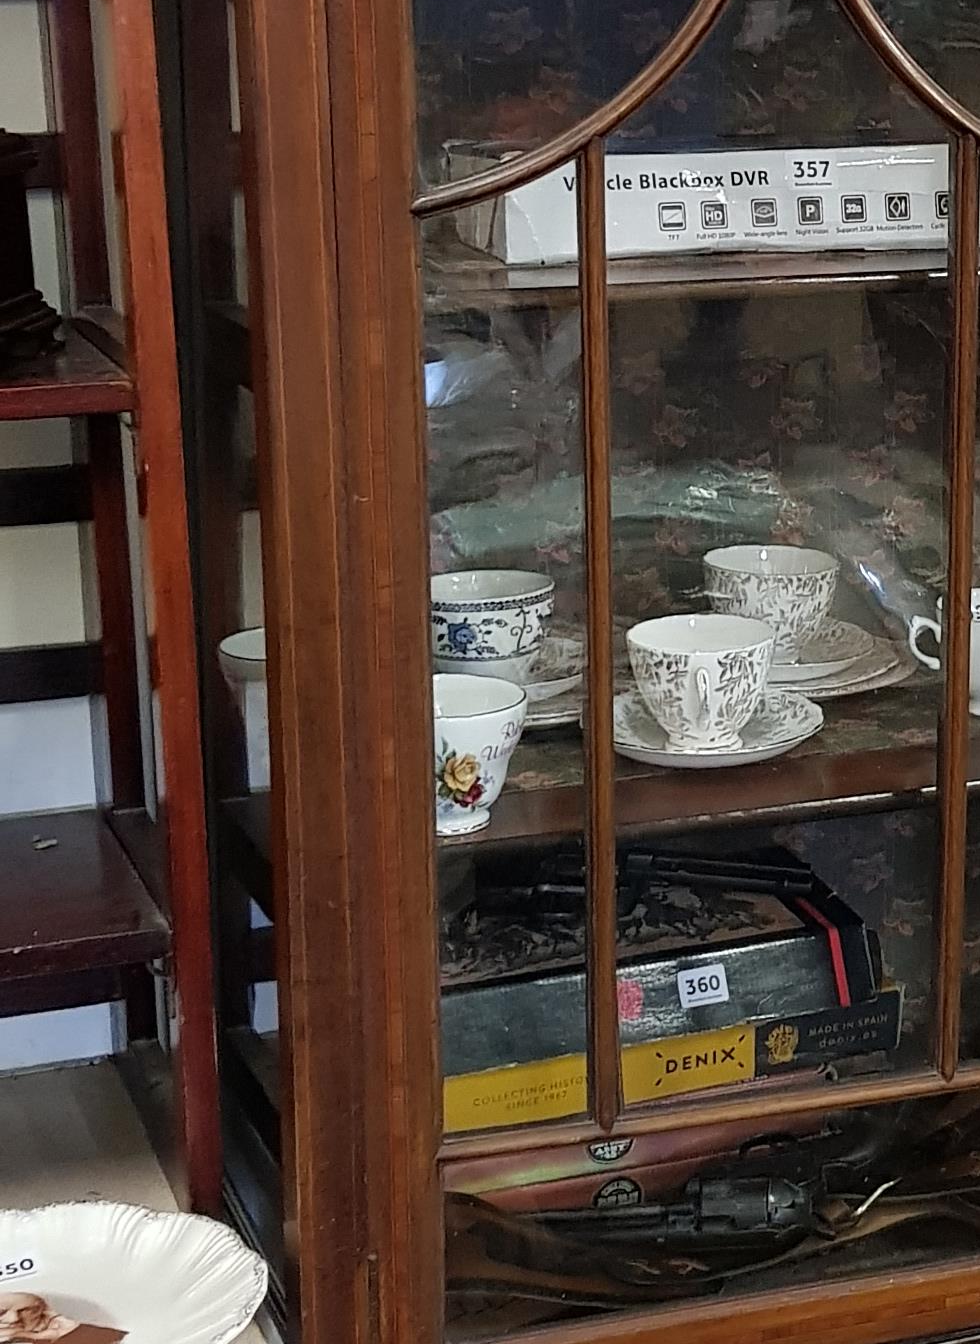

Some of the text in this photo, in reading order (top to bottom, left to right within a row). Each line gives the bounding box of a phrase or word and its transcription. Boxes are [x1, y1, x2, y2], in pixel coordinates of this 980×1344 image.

[793, 160, 831, 178] 357
[562, 169, 770, 192] Vcle Blackbox DVR
[705, 210, 723, 222] HD
[684, 974, 722, 996] 360
[808, 1022, 840, 1037] MADE
[858, 1013, 889, 1027] SPAIN
[665, 1047, 736, 1074] DENIX
[0, 1258, 34, 1276] 50
